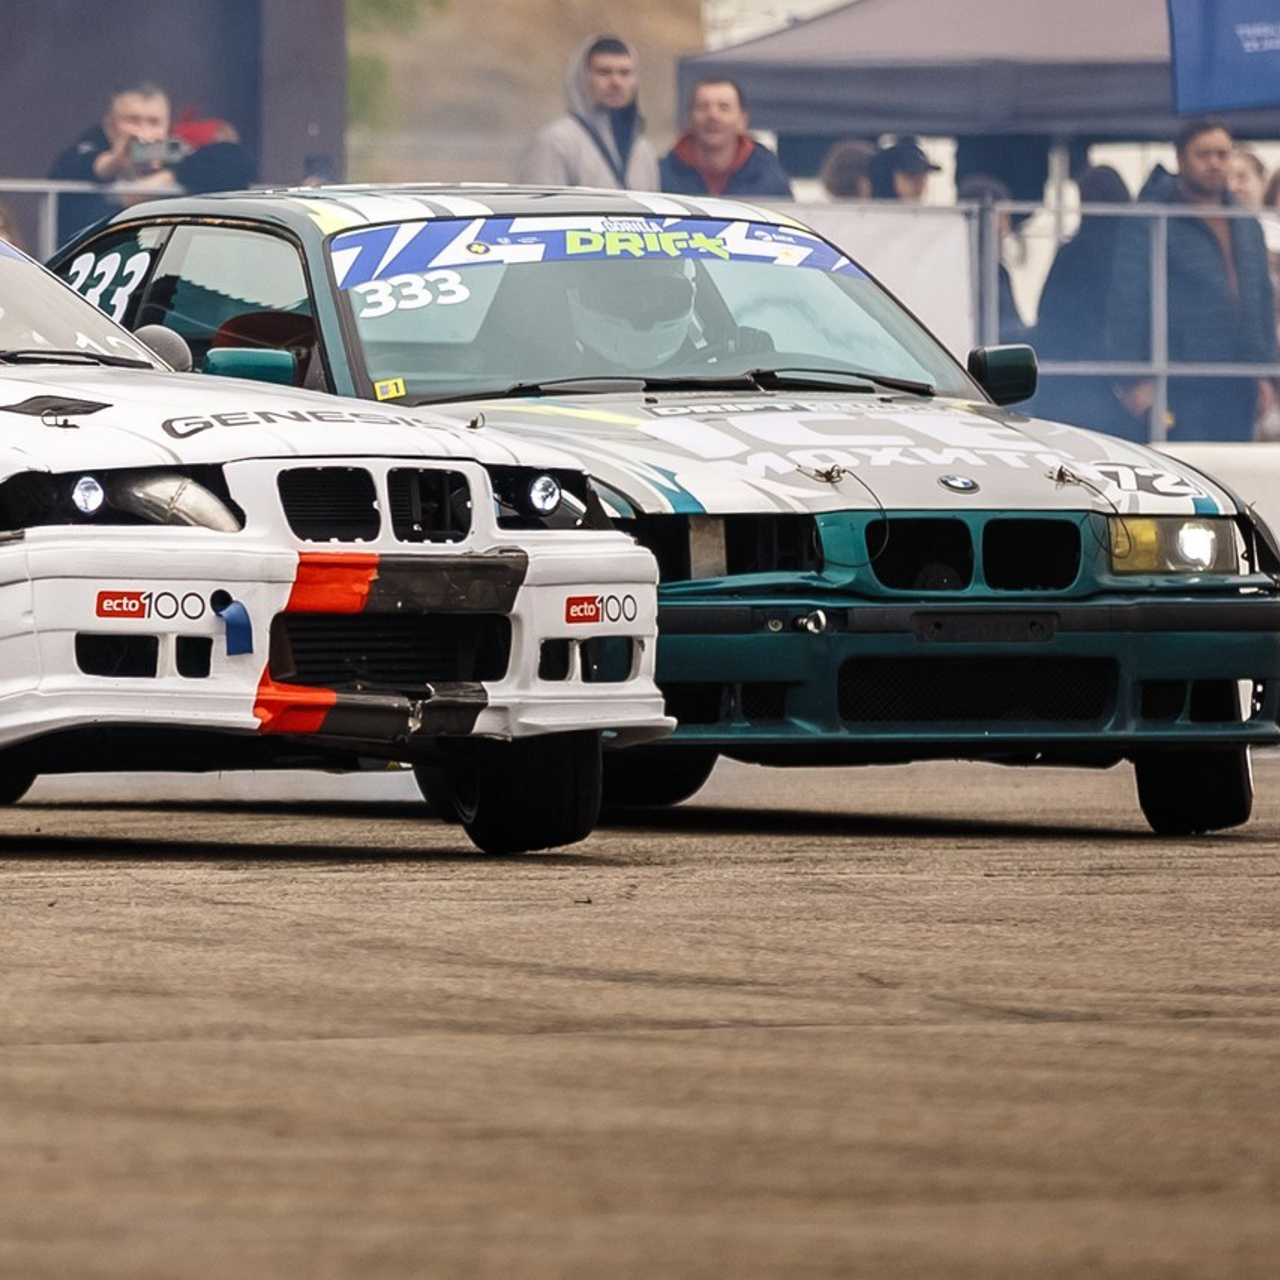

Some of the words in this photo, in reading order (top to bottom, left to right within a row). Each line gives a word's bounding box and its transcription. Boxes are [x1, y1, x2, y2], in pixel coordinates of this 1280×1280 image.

[565, 230, 730, 261] DRIFT
[353, 269, 471, 318] 333
[651, 403, 796, 417] DRIFT
[635, 413, 1050, 459] ICE
